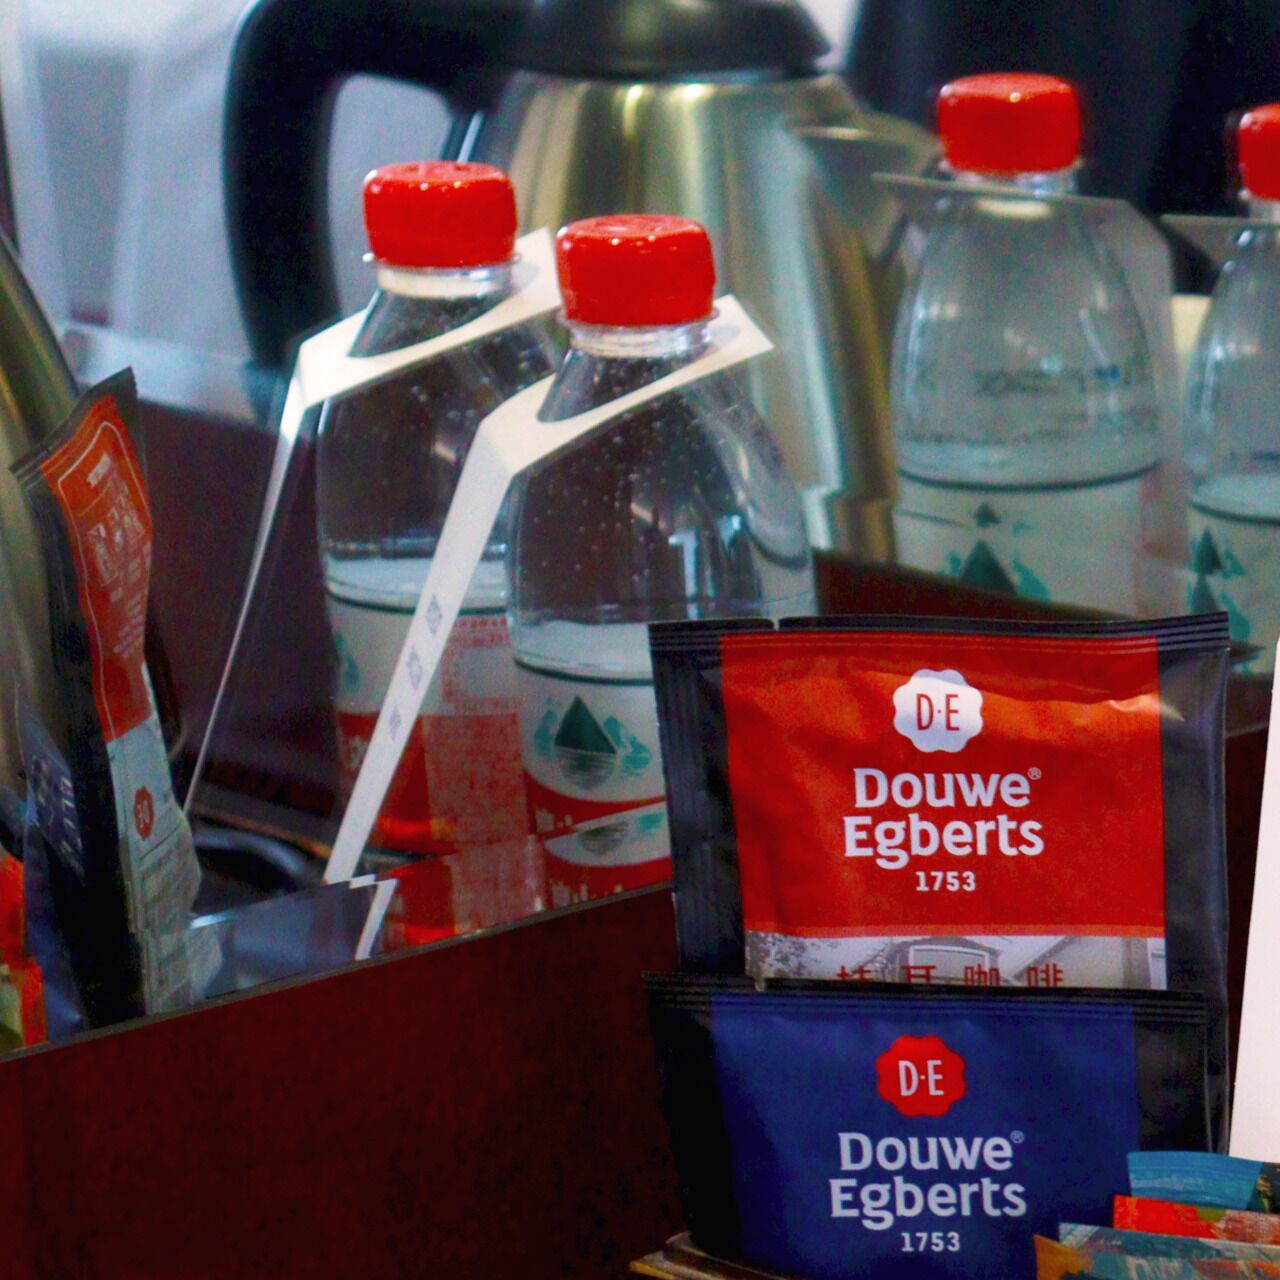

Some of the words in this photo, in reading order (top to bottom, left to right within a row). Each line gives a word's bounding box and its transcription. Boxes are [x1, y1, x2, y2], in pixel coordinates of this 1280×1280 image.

[844, 813, 1044, 869] Egberts
[916, 871, 976, 892] 1753
[829, 1176, 1027, 1230] Egberts
[901, 1231, 961, 1252] 1753
